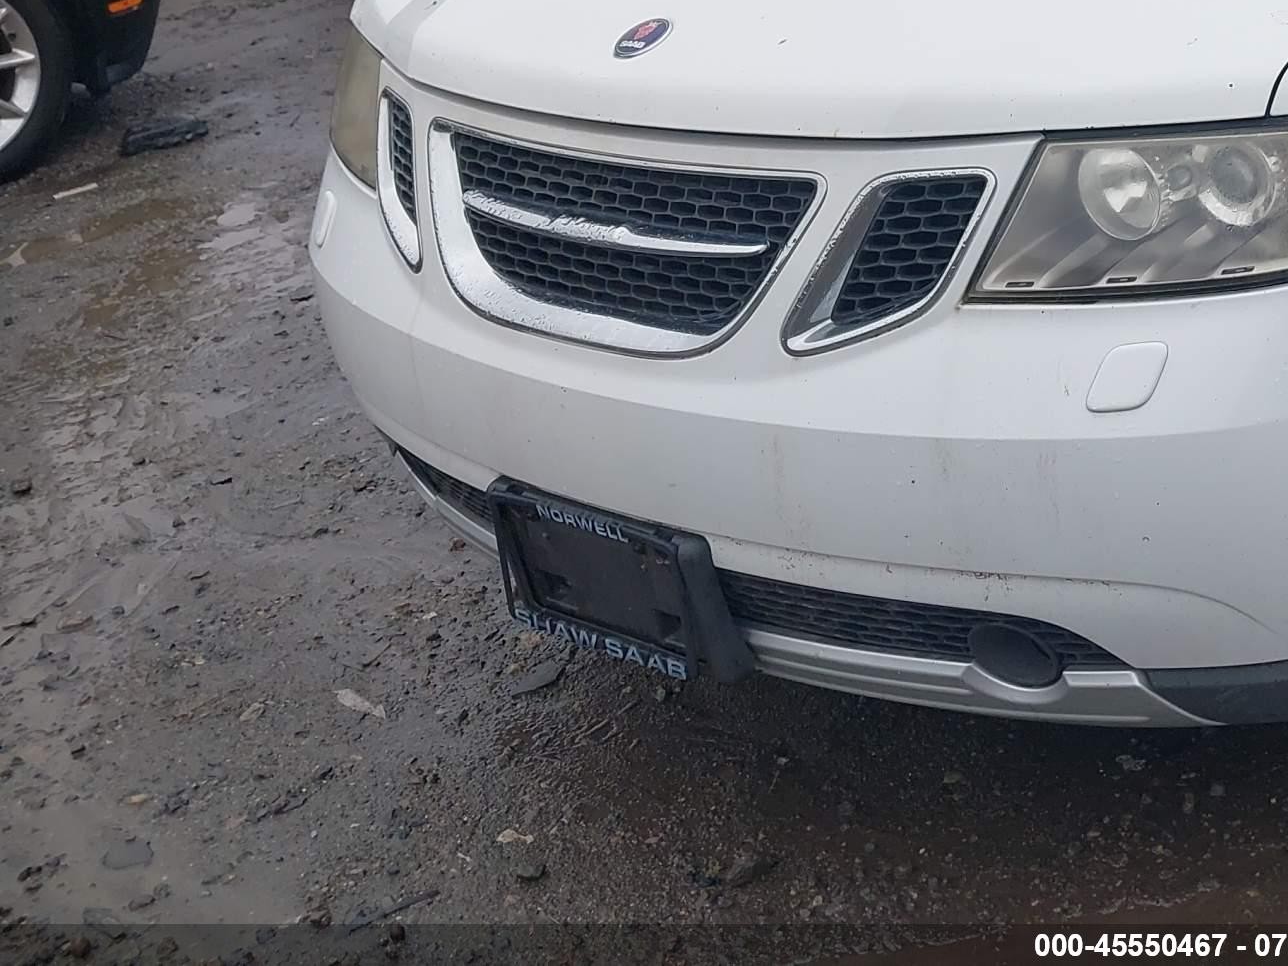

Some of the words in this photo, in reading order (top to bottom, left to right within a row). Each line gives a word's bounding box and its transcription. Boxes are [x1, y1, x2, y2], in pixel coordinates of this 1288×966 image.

[536, 504, 629, 543] NORWELL
[514, 609, 598, 650] SHAW
[604, 638, 688, 681] SAAB
